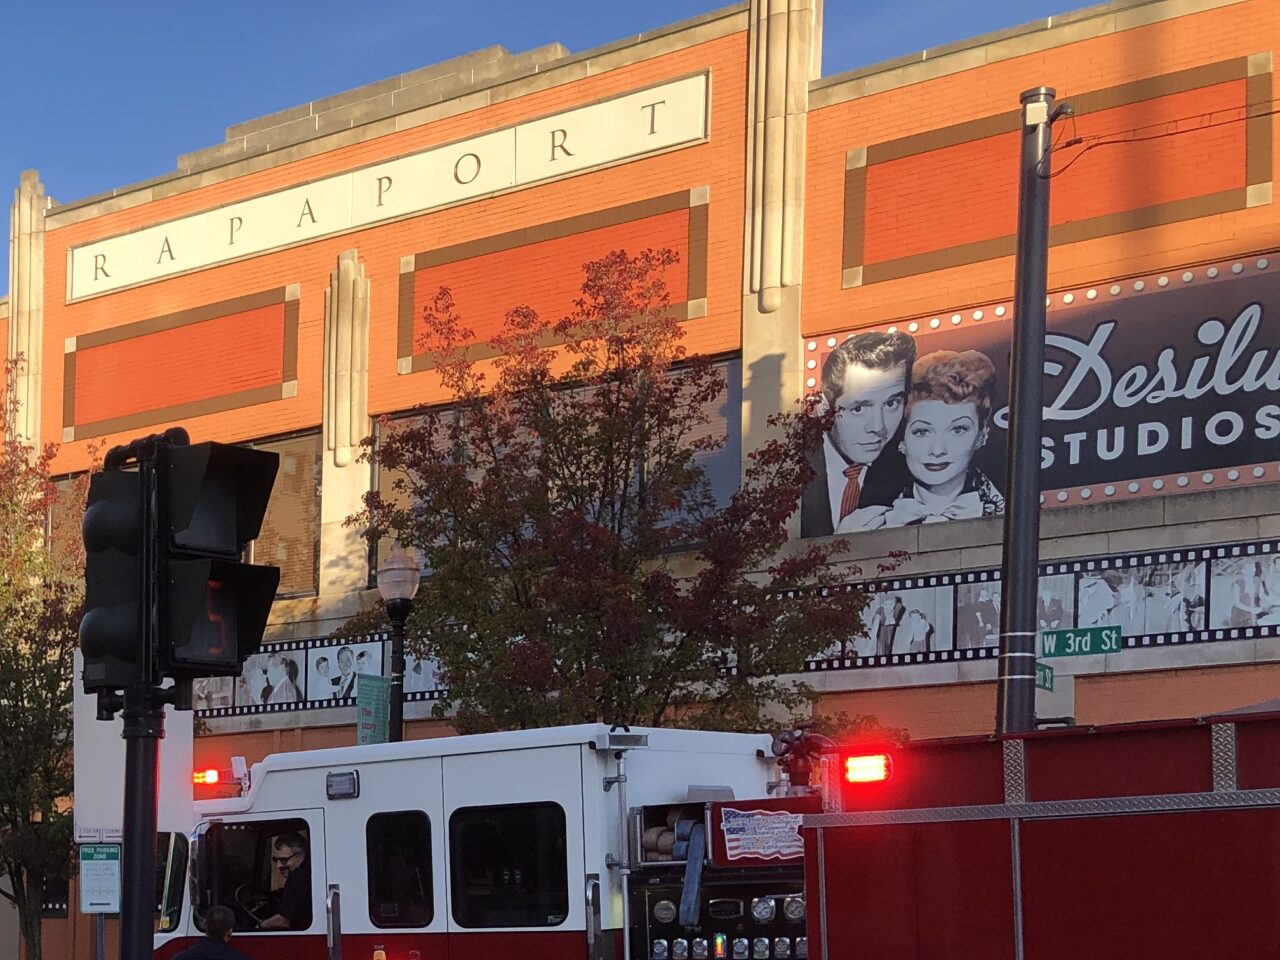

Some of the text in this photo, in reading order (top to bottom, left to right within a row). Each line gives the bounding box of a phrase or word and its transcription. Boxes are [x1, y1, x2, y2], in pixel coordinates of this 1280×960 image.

[93, 99, 667, 281] RAPAPORT
[993, 303, 1280, 429] Desilu
[1041, 404, 1280, 470] STUDIOS
[1043, 630, 1118, 654] W 3rd St
